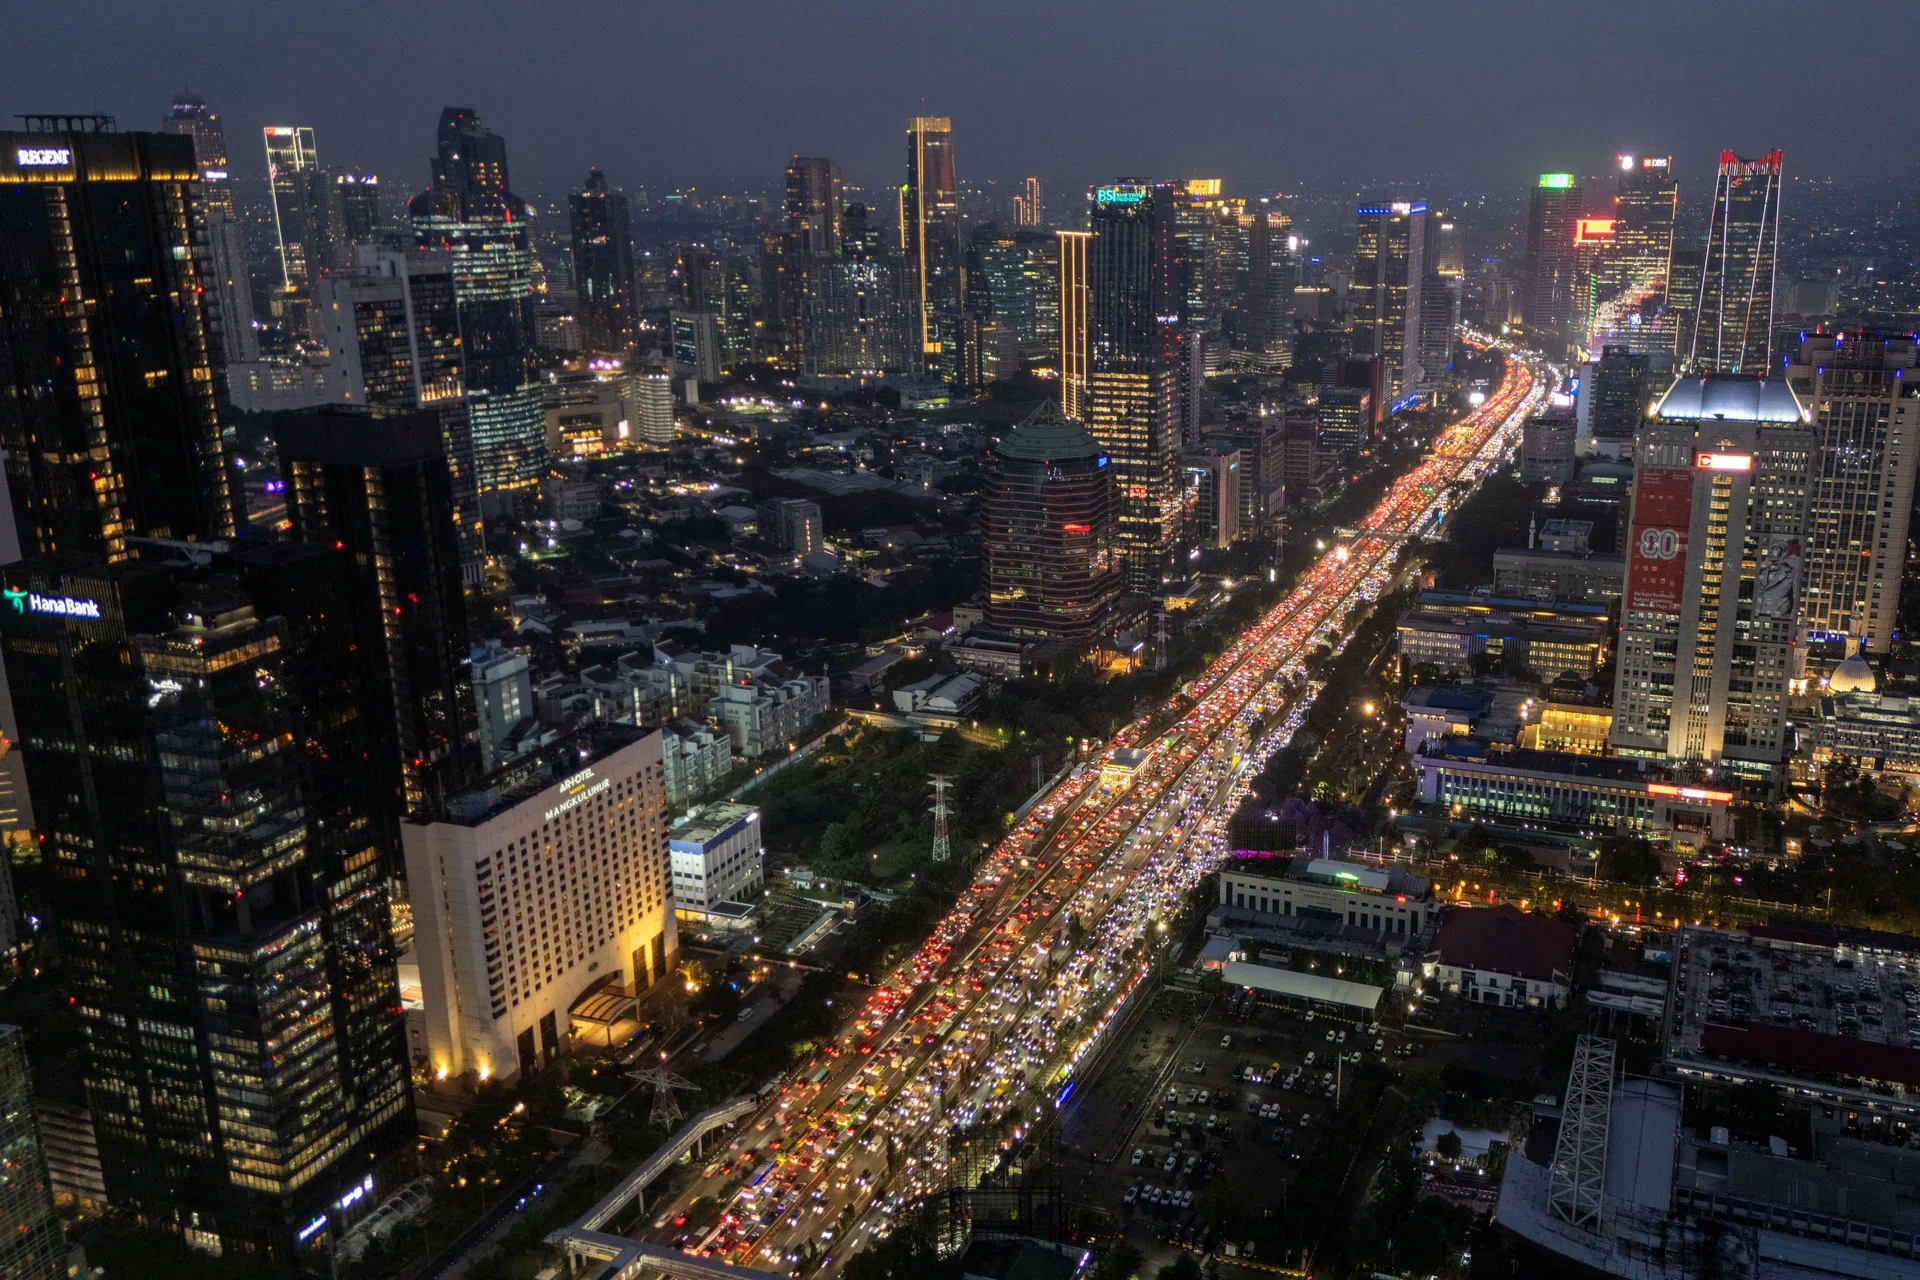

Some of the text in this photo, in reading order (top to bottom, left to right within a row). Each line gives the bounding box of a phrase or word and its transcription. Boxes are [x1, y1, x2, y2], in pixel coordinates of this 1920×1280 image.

[18, 149, 70, 166] REGENT
[1651, 158, 1667, 167] DBS
[1097, 189, 1116, 202] BSI
[1640, 527, 1680, 561] 80
[544, 778, 610, 821] MANGKULUHUR
